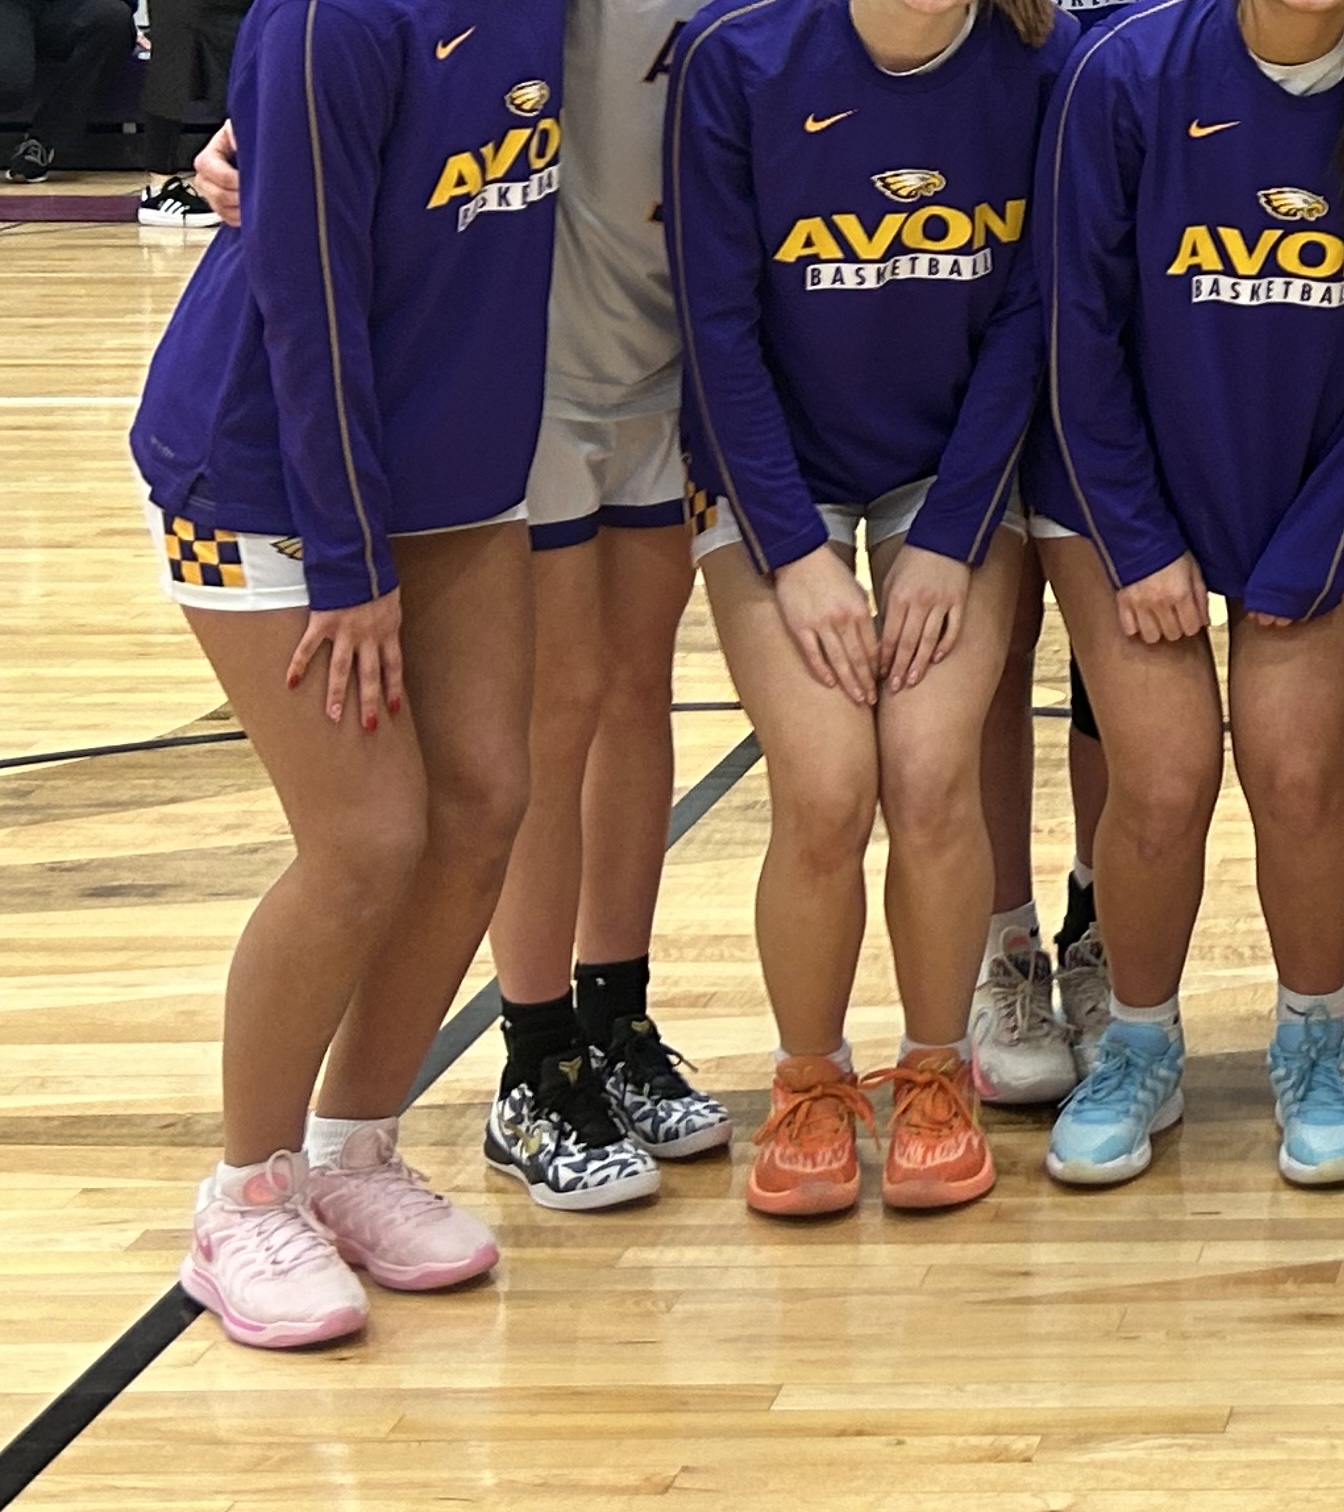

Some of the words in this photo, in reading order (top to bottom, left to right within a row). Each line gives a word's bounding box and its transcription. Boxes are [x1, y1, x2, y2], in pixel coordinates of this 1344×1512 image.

[426, 116, 562, 209] AVO
[773, 199, 1026, 263] AVON
[810, 251, 991, 287] BASKETBALL
